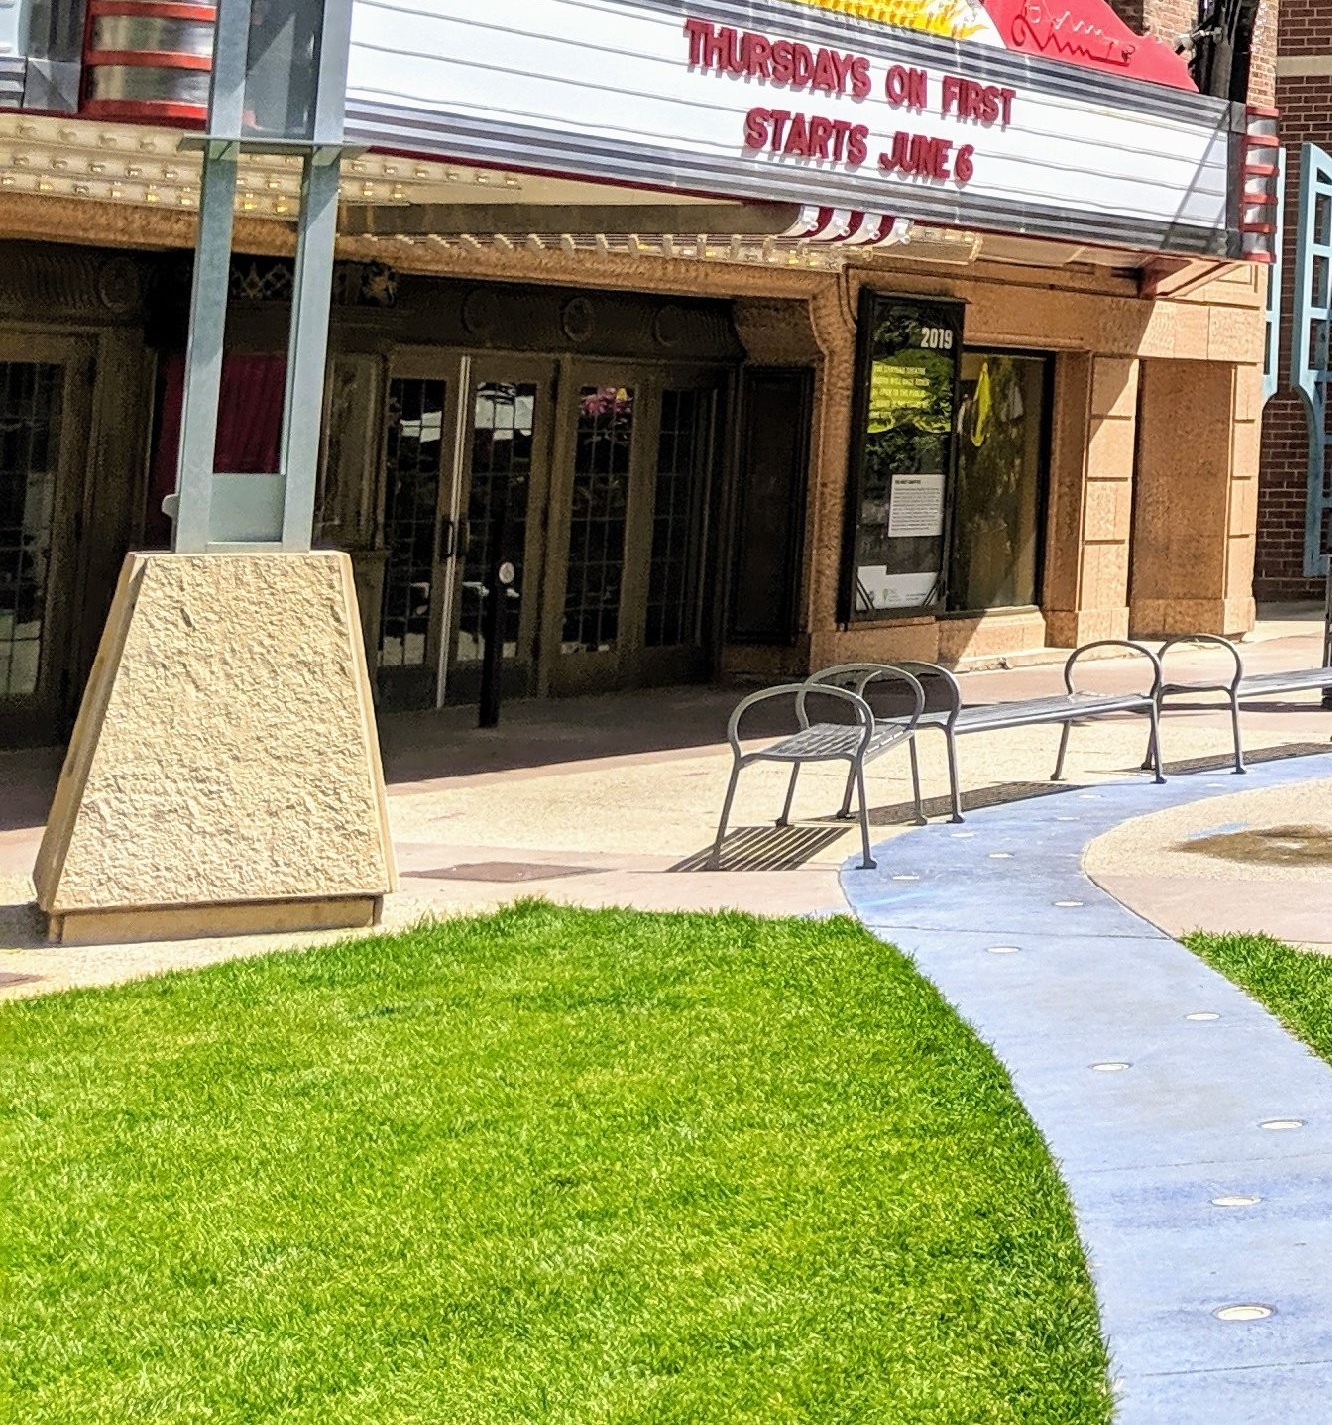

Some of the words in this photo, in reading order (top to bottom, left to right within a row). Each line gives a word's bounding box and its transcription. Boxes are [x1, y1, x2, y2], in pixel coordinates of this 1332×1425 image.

[684, 17, 872, 100] THURSDAYS
[885, 64, 928, 109] ON
[941, 75, 1016, 126] FIRST
[745, 107, 869, 166] STARTS
[879, 131, 953, 179] JUNE
[954, 143, 975, 182] 6
[920, 327, 953, 349] 2019
